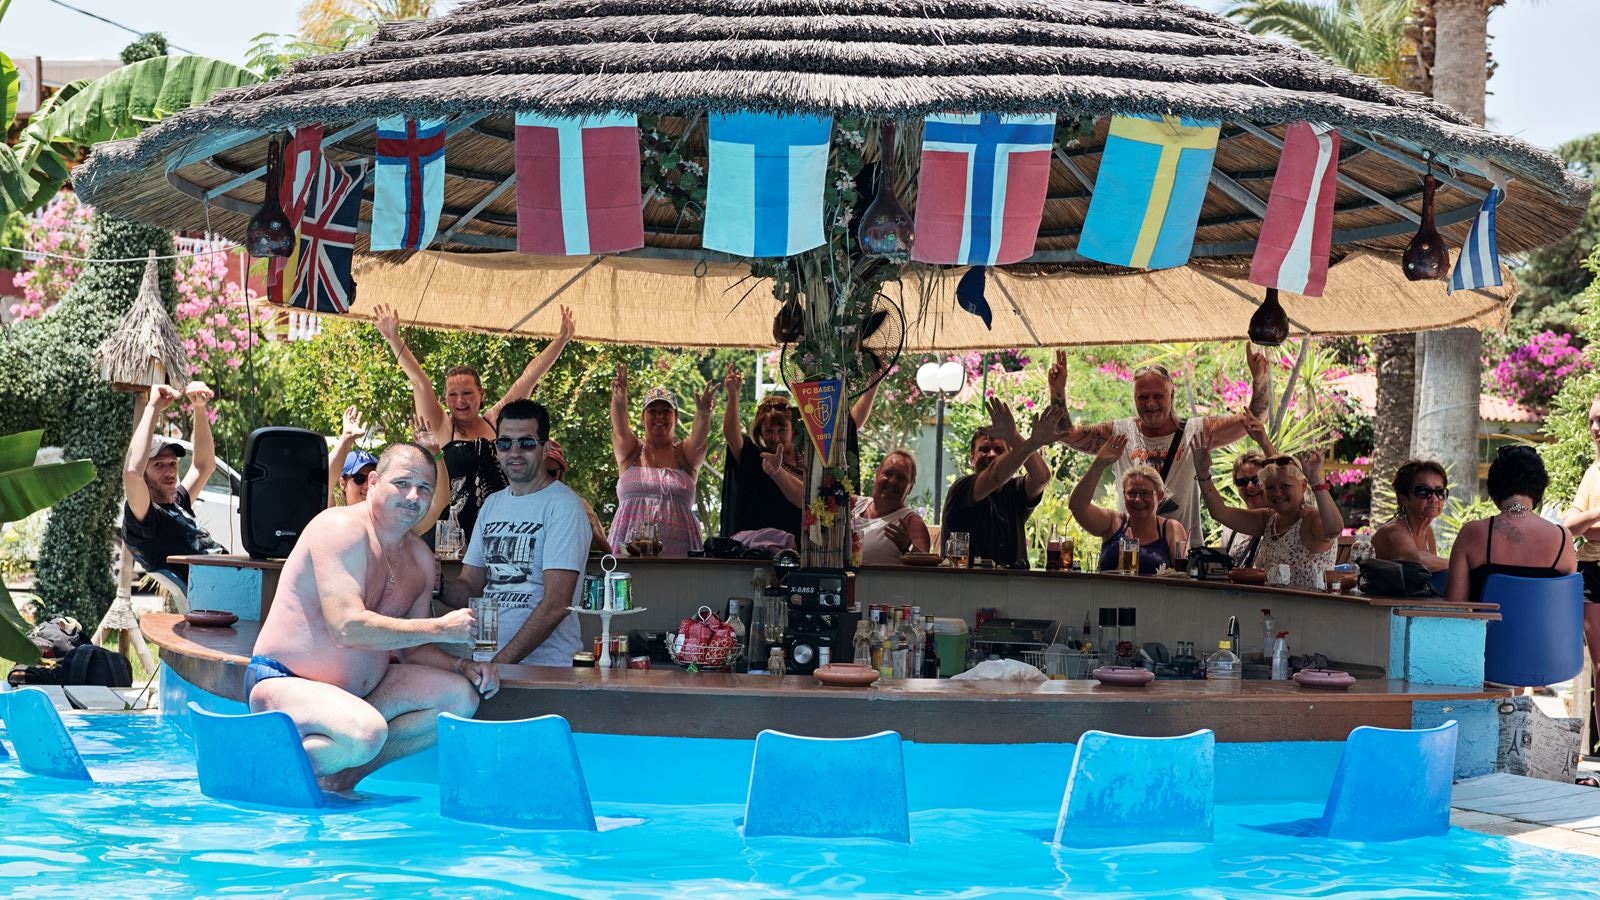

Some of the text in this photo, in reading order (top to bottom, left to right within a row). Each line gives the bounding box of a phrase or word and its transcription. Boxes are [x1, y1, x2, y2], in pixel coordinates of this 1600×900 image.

[813, 385, 836, 394] BASEL
[514, 521, 544, 535] CAR
[790, 585, 815, 594] X-BASS
[496, 592, 532, 603] FUTURE
